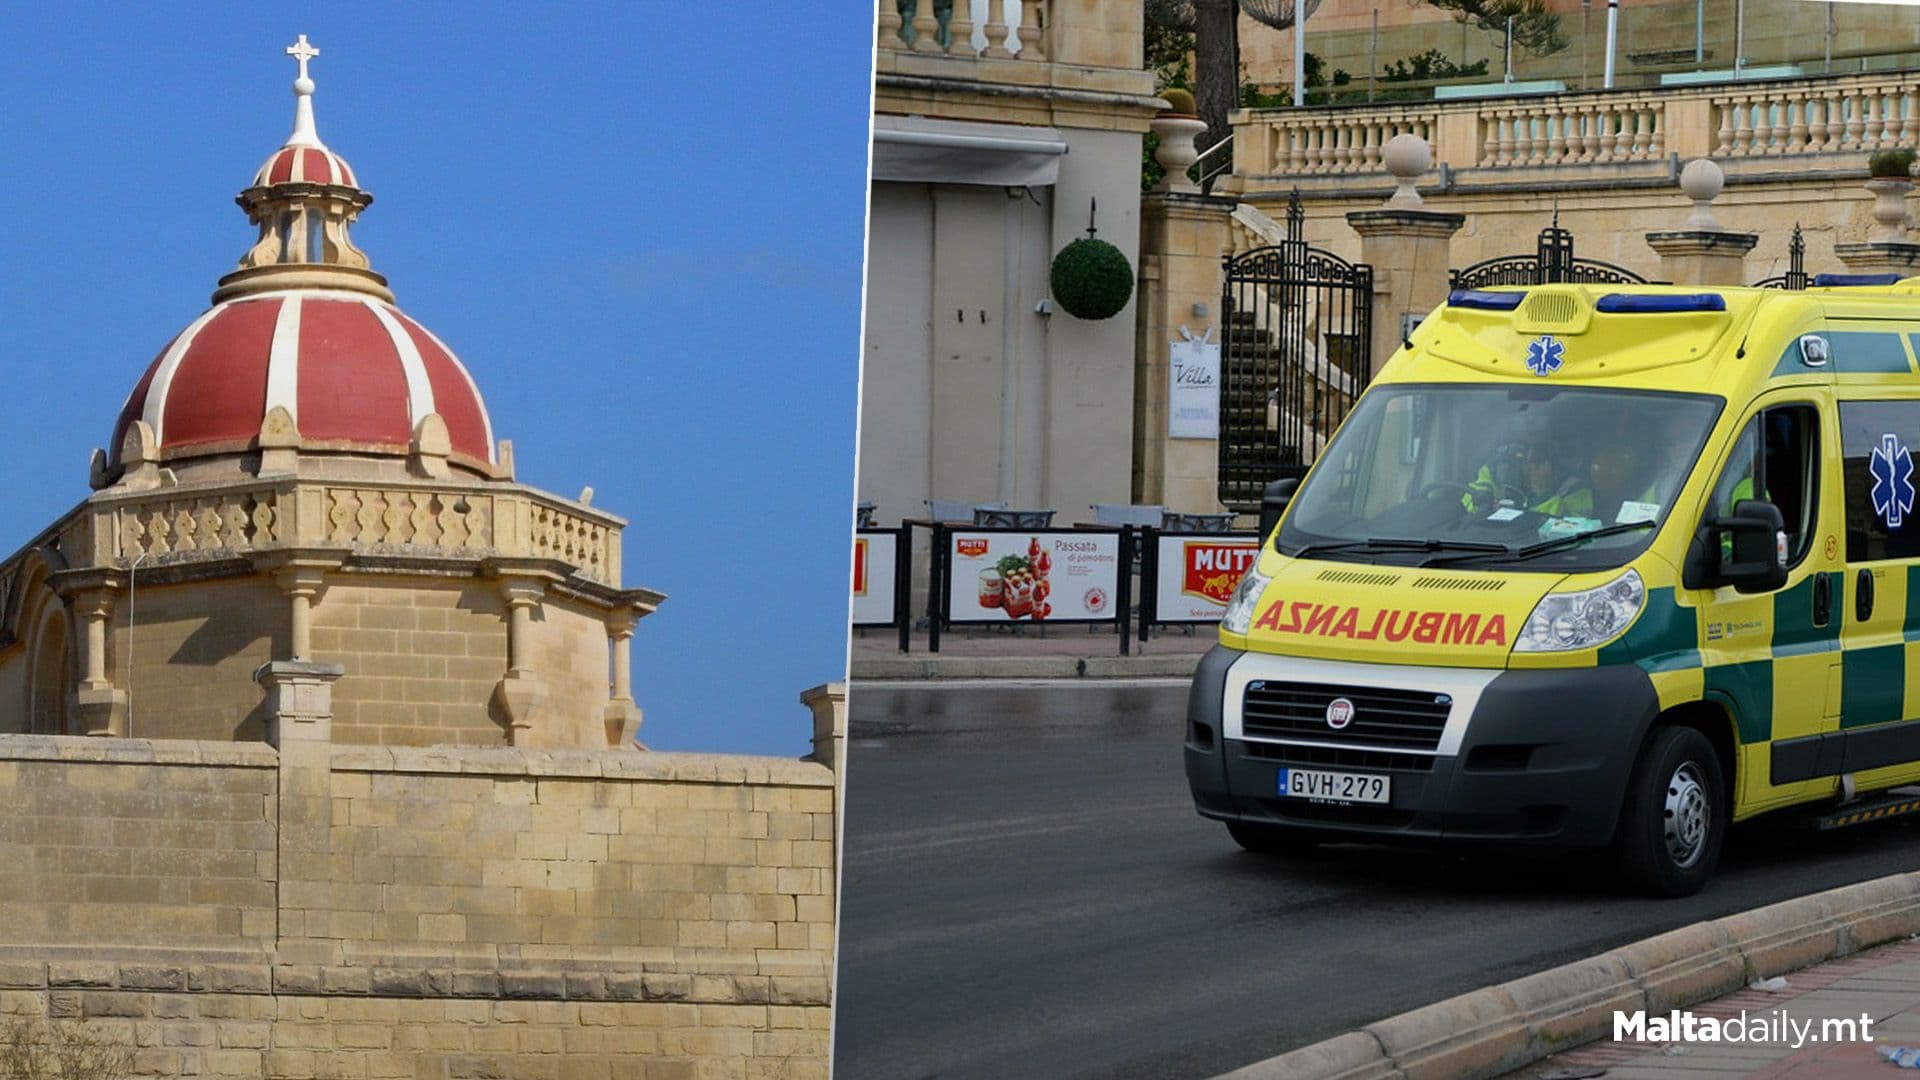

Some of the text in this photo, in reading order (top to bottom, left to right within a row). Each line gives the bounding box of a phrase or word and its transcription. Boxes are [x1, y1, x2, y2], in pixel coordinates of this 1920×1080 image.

[1174, 364, 1214, 385] Villa
[1055, 540, 1098, 552] Passata
[1077, 554, 1114, 563] pomodoro
[1292, 772, 1384, 800] GVH 279
